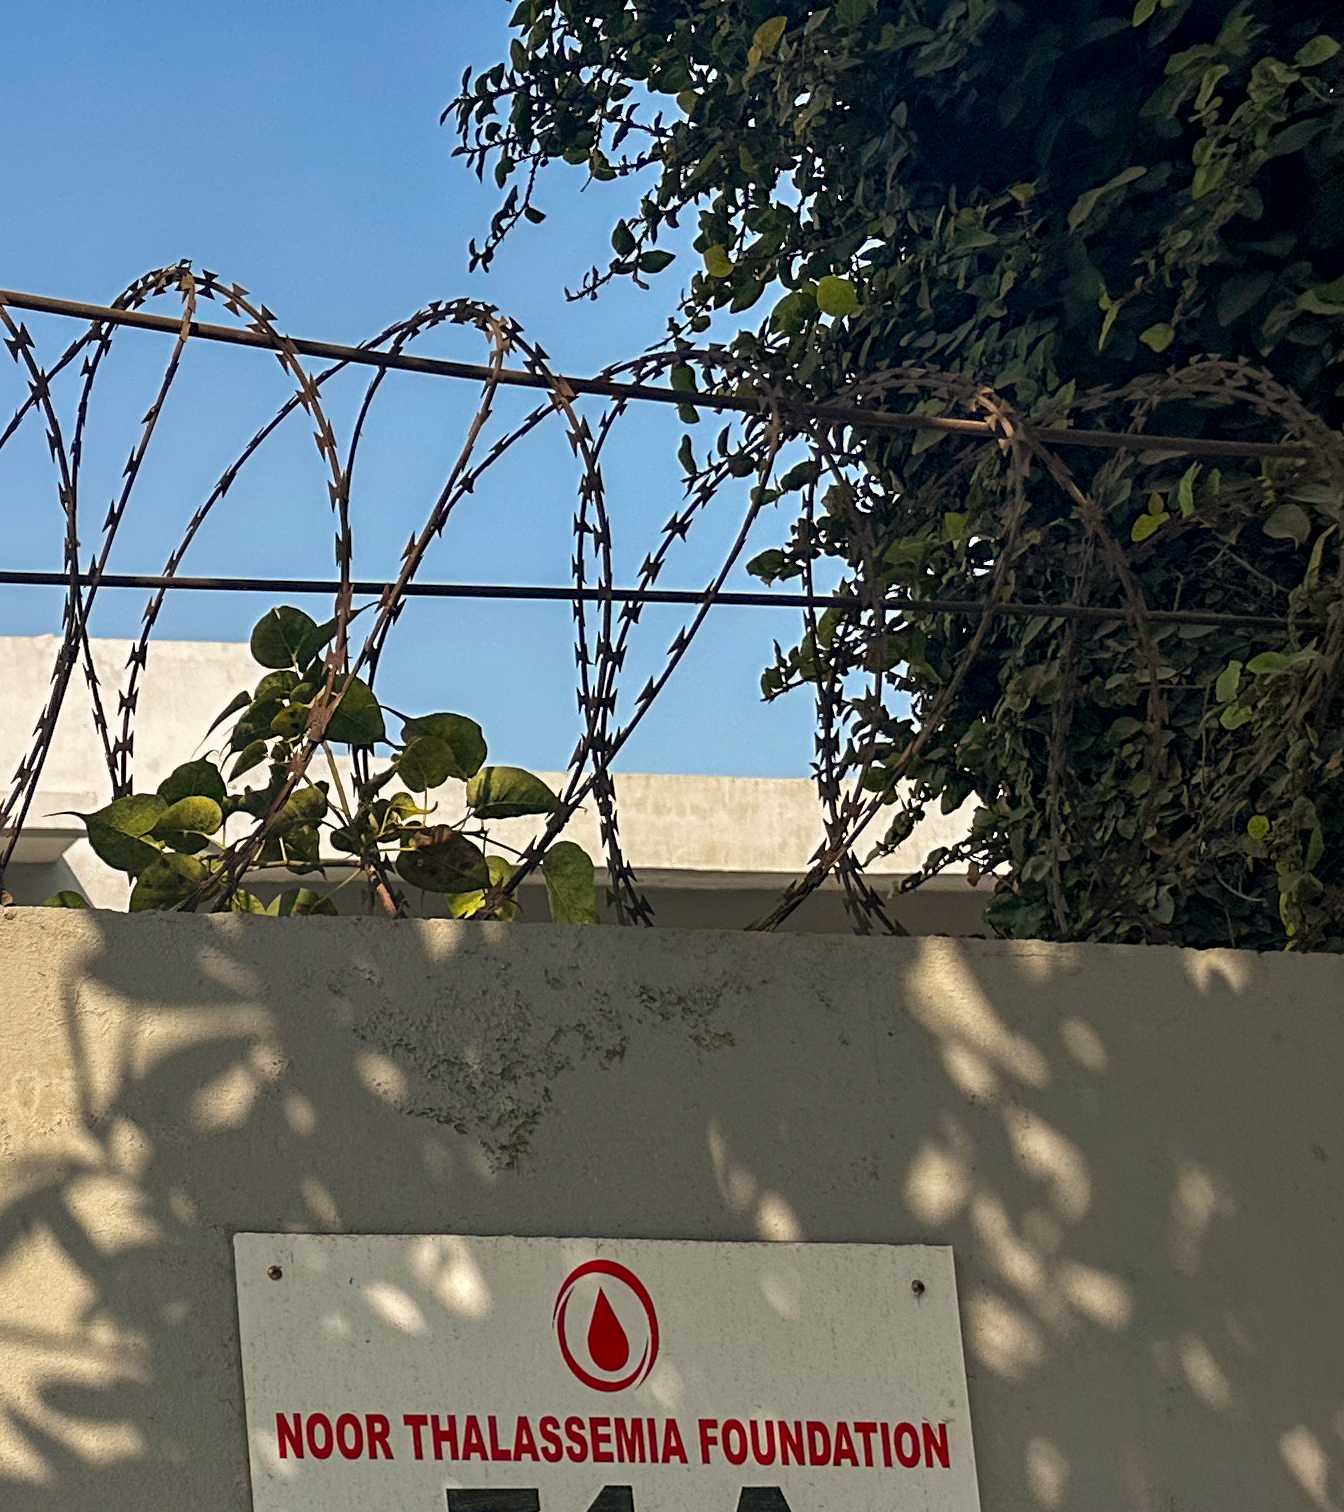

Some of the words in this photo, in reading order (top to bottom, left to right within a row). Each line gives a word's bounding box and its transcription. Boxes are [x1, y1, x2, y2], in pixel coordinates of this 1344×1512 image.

[275, 1412, 395, 1461] NOOR
[402, 1414, 689, 1465] THALASSEMIA
[698, 1418, 952, 1469] FOUNDATION
